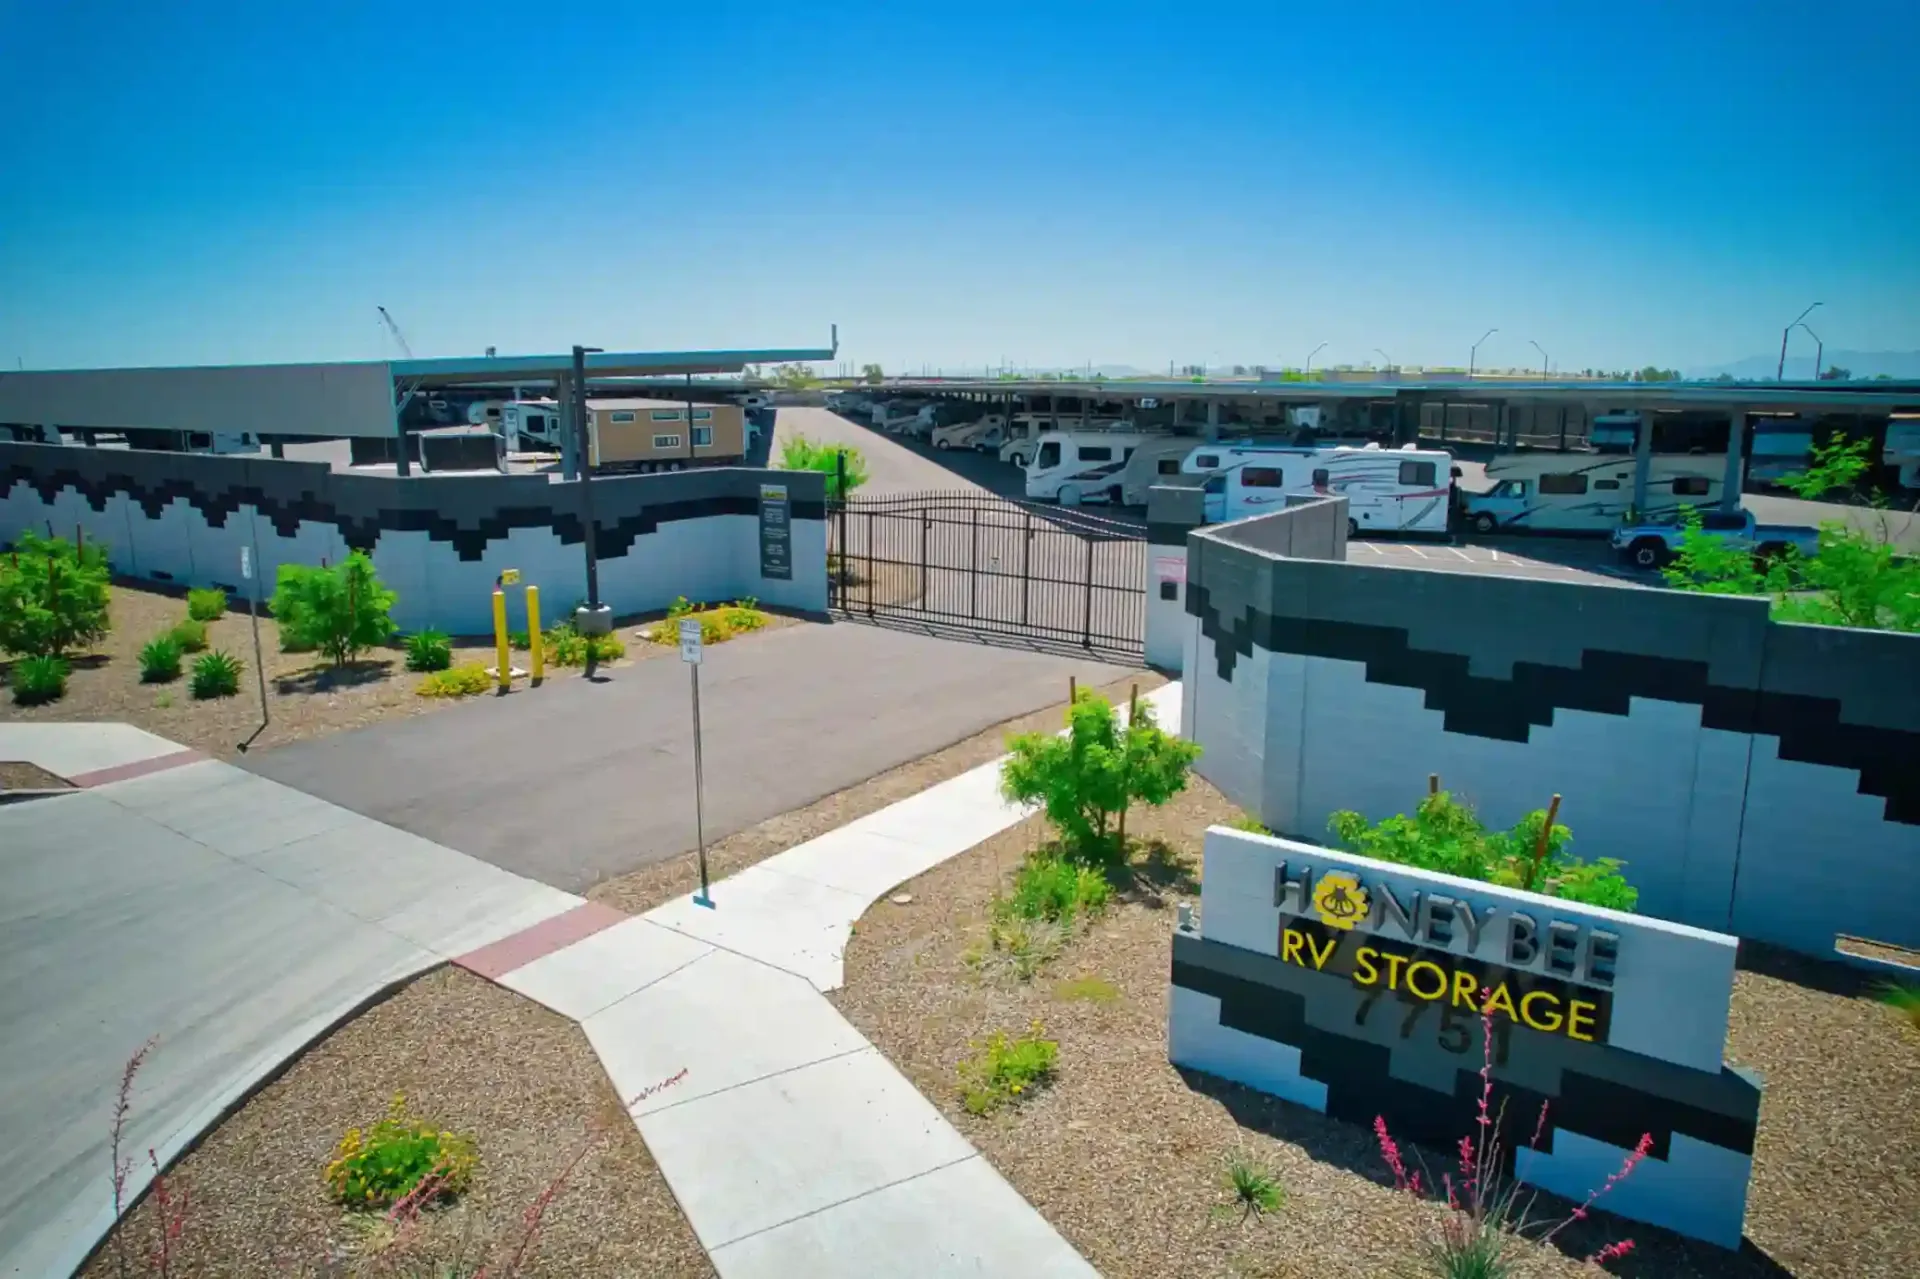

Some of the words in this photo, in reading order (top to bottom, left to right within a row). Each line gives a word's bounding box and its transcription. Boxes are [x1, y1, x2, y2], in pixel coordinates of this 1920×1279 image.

[1282, 928, 1337, 972] RV
[1352, 946, 1598, 1042] STORAGE
[1505, 911, 1620, 987] BEE
[1353, 984, 1513, 1067] 7751
